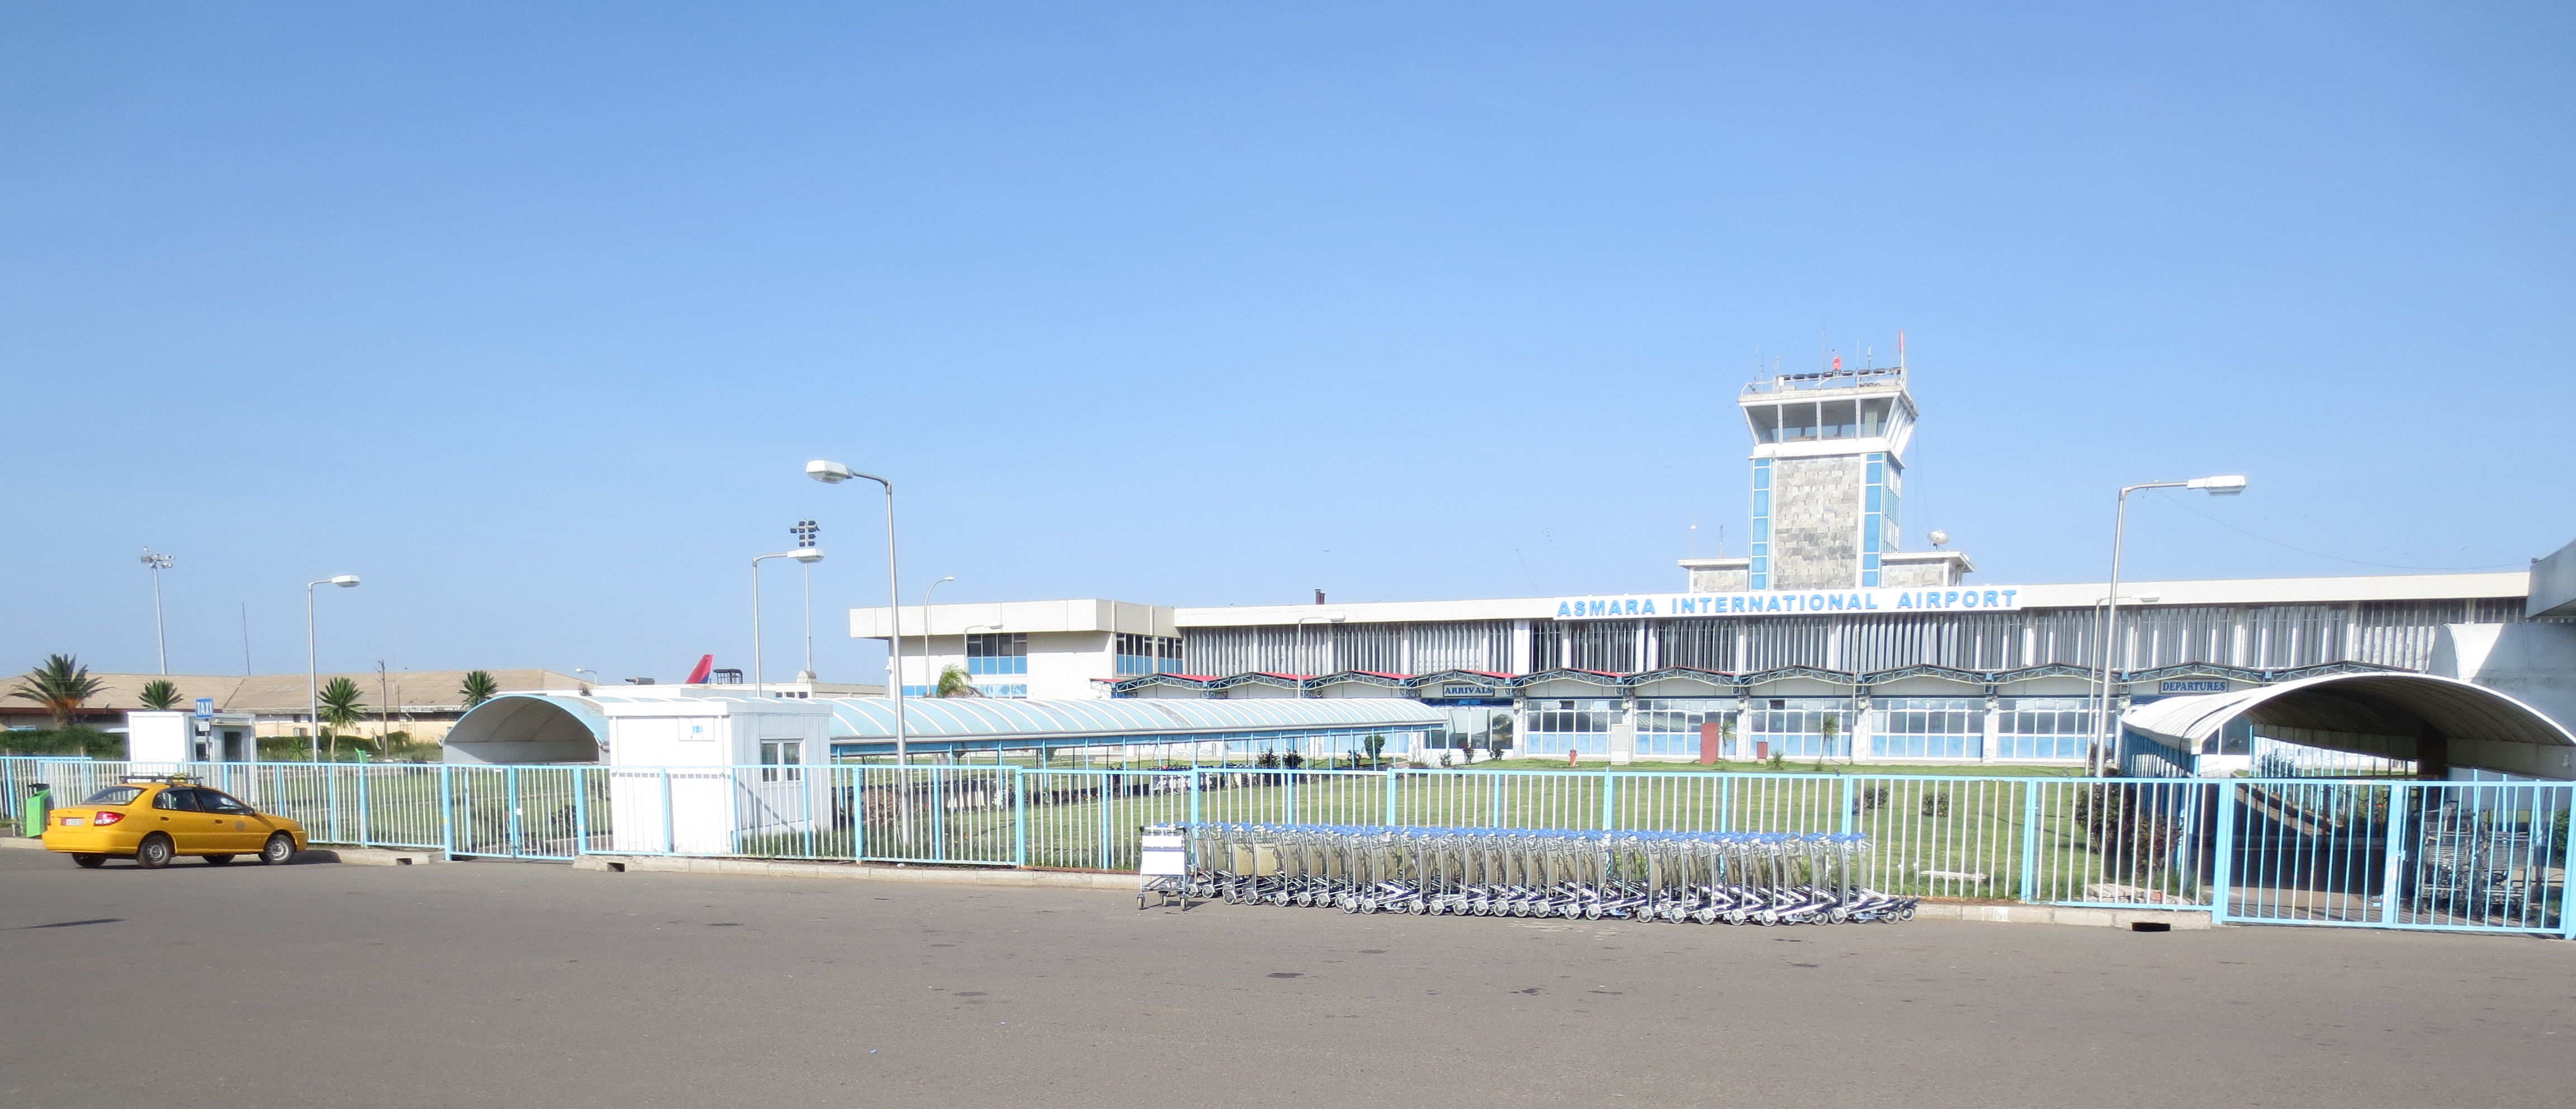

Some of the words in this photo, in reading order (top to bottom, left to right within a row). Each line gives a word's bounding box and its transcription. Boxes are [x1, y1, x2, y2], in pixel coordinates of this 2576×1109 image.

[1557, 599, 1656, 617] ASMARA
[1671, 593, 1878, 614] INTERNATIONAL
[1896, 589, 2018, 610] AIRPORT
[2162, 681, 2226, 691] DEPARTURES
[197, 702, 212, 715] TAXI
